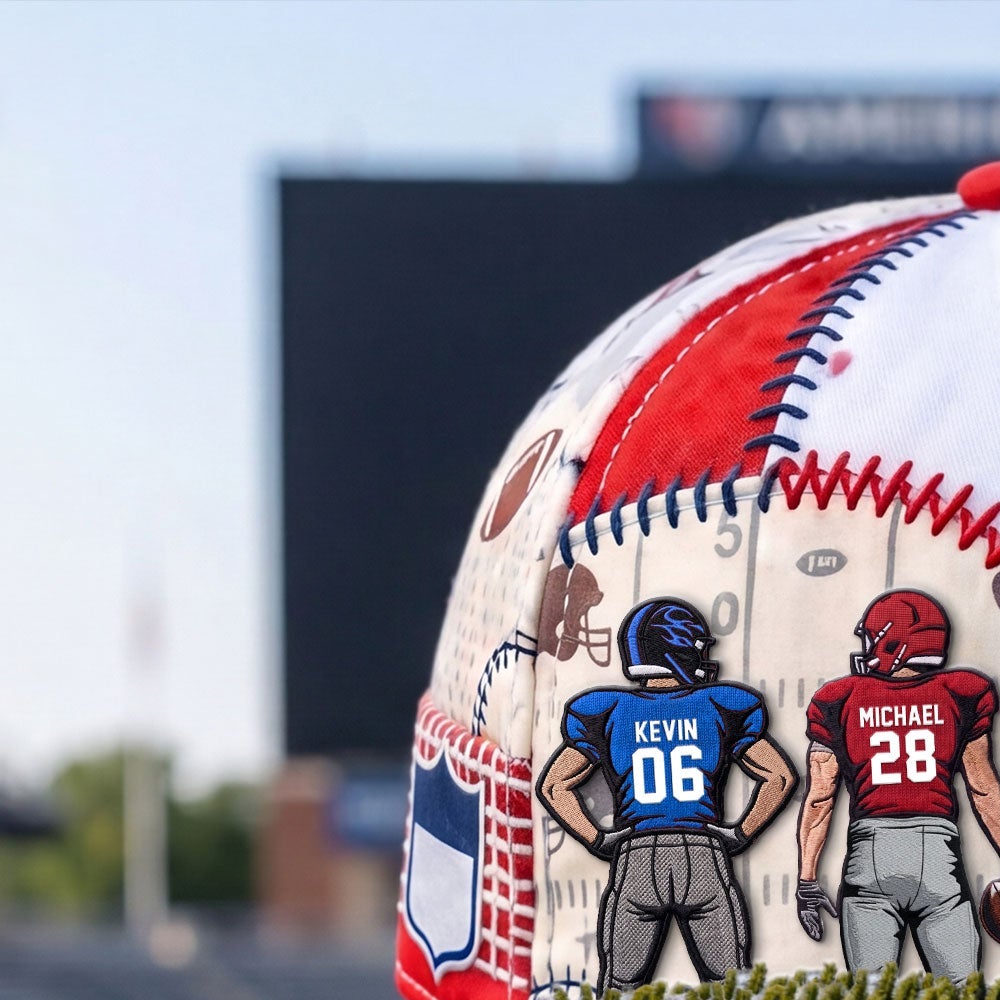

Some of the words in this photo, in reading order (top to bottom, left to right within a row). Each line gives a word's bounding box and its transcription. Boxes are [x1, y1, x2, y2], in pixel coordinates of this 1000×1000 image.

[634, 718, 698, 743] KEVIN
[858, 704, 945, 728] MICHAEL
[631, 744, 705, 804] 06
[869, 728, 937, 785] 28
